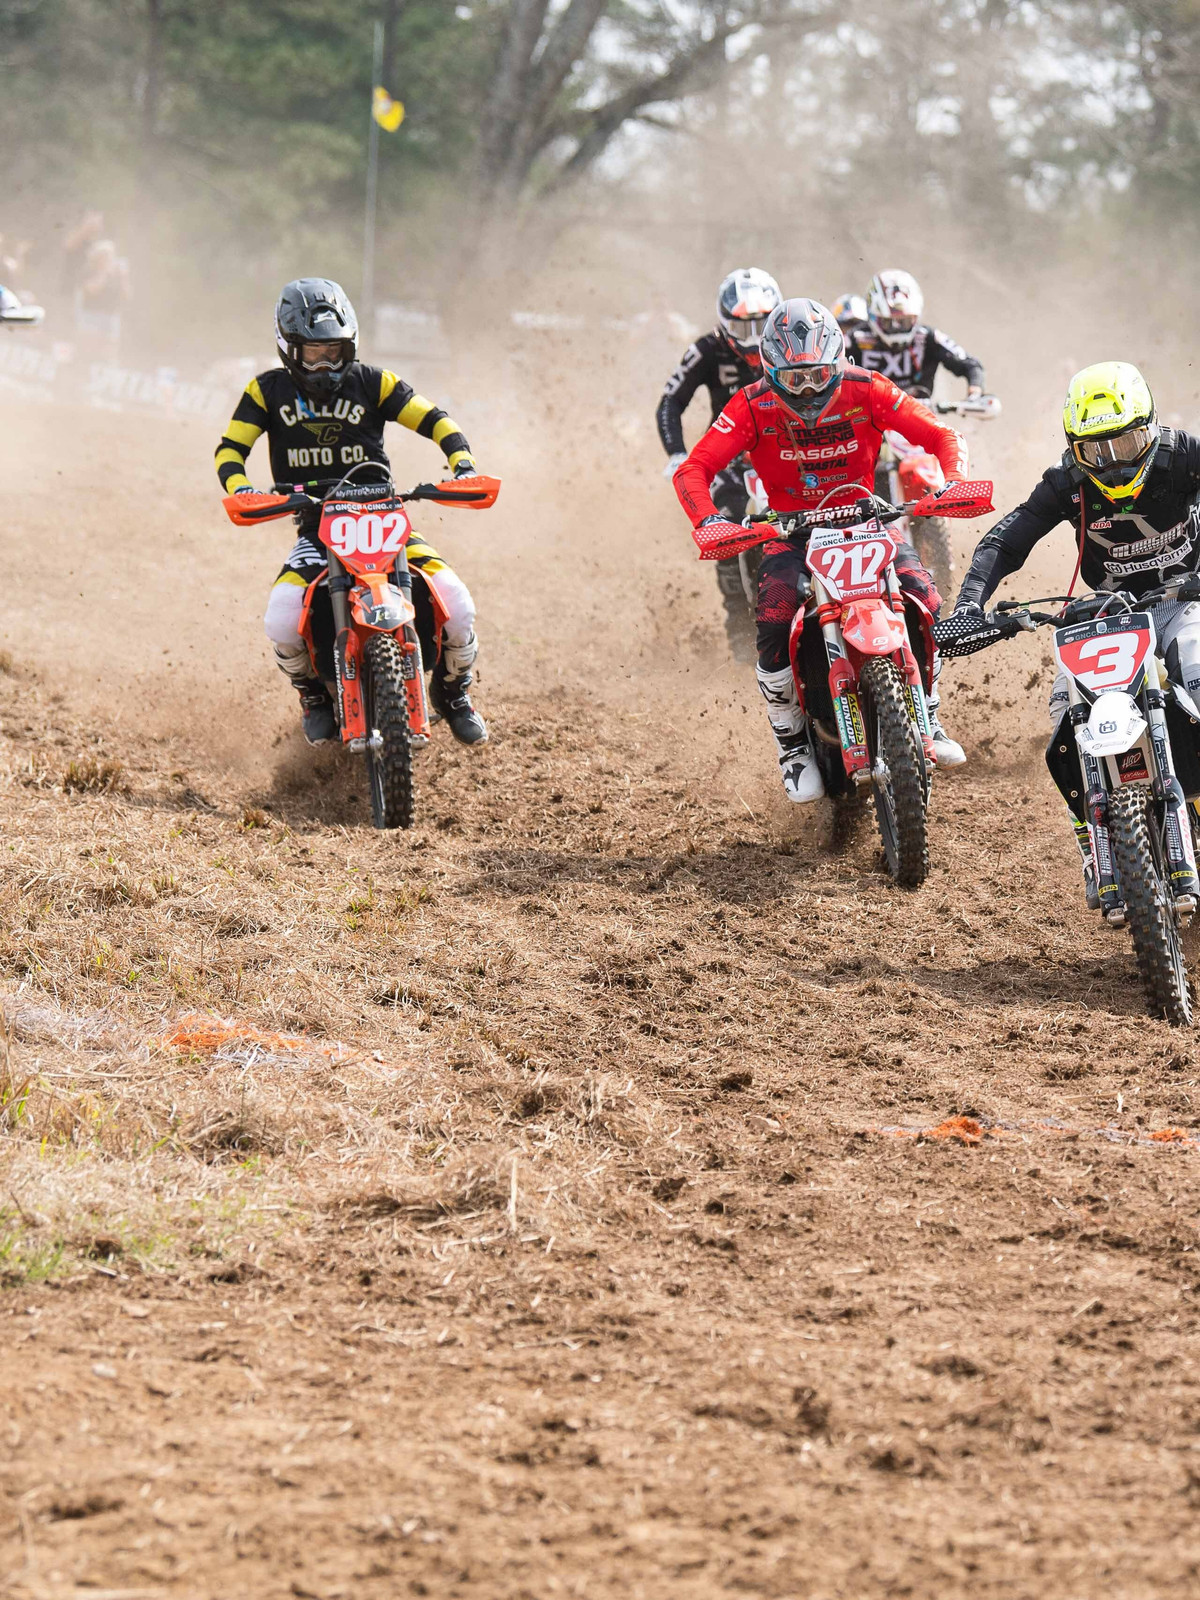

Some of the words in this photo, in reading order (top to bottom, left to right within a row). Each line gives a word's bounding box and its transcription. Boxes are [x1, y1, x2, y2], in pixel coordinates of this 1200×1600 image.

[279, 398, 365, 427] CALLUS
[287, 448, 334, 467] MOTO
[340, 444, 370, 464] CO.
[780, 439, 859, 461] GASGAS
[804, 506, 863, 523] RENTHA
[330, 512, 407, 557] 902
[821, 541, 886, 588] 212
[1123, 541, 1190, 573] Husqvarna
[955, 628, 1001, 646] ACERBIS
[1074, 632, 1140, 691] 3
[841, 695, 857, 745] DUNLOP
